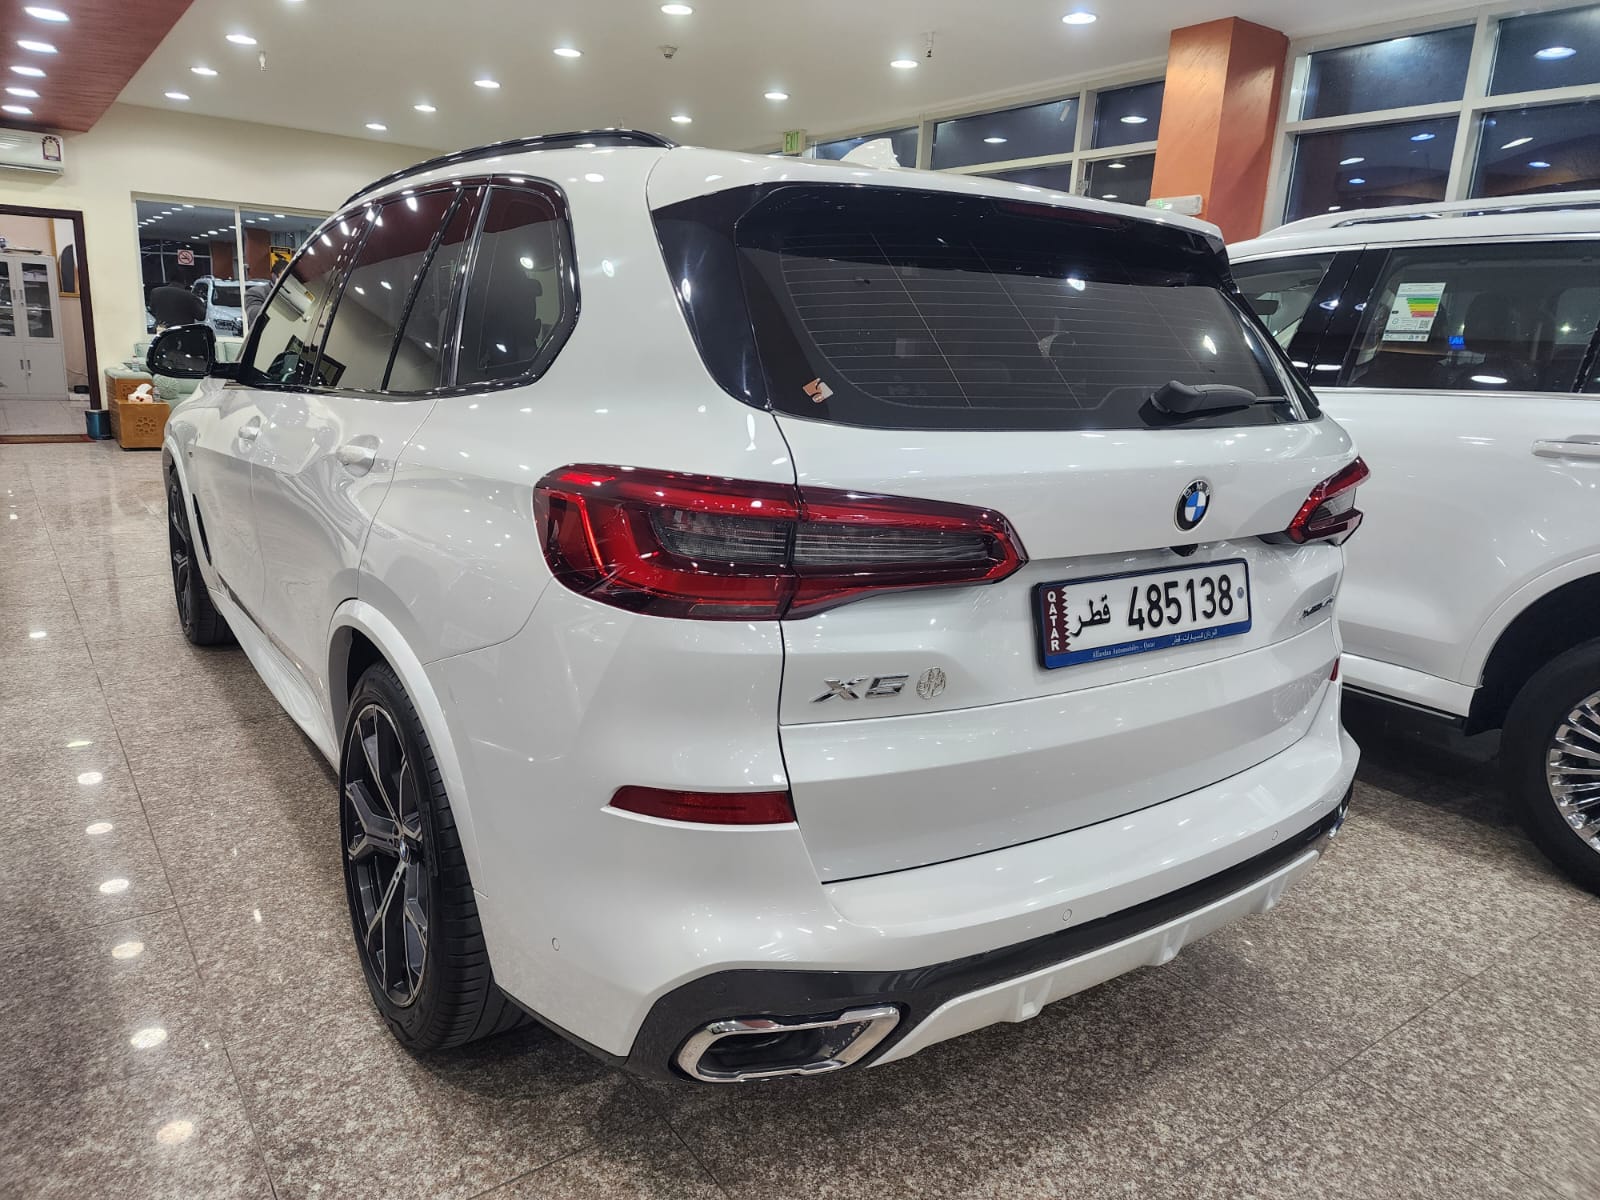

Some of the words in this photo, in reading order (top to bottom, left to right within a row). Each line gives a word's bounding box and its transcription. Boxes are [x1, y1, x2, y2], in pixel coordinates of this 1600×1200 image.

[785, 131, 800, 153] EXIT
[1047, 590, 1060, 651] QATAR
[1070, 594, 1111, 637] قطر
[1127, 574, 1234, 631] 485138
[810, 674, 909, 703] X5
